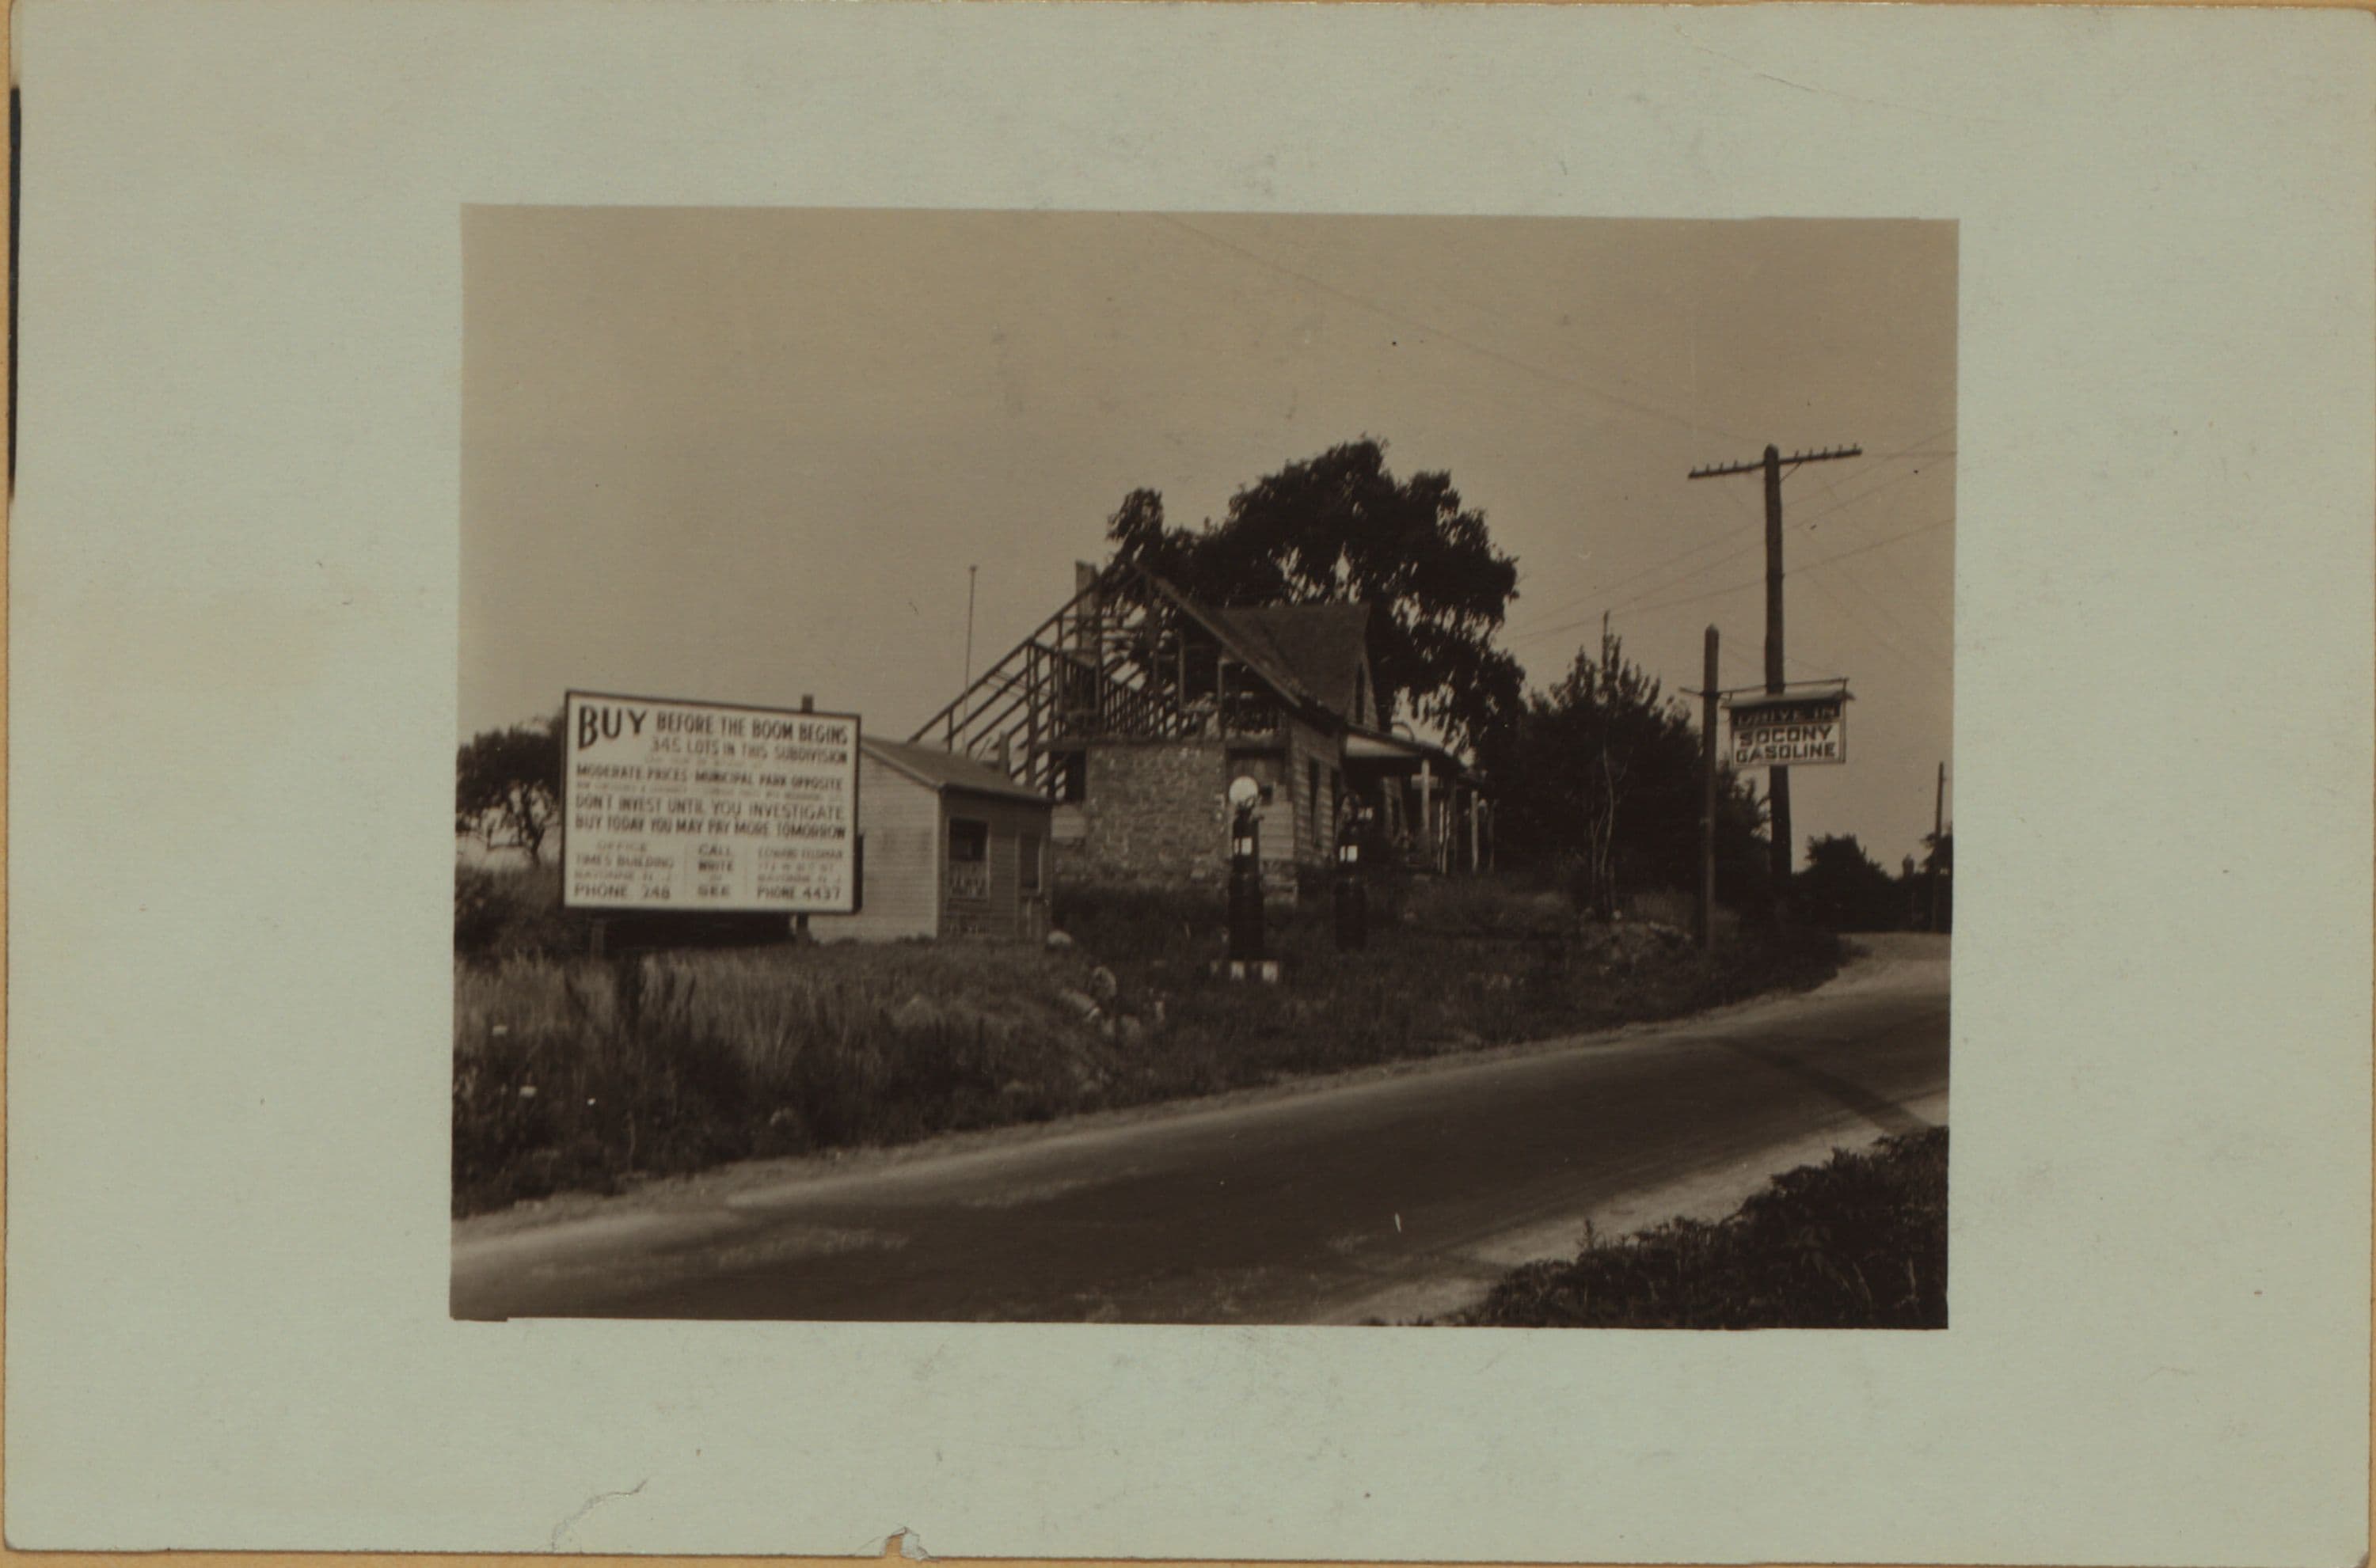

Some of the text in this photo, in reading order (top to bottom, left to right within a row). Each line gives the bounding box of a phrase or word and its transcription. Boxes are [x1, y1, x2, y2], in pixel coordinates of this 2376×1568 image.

[578, 705, 647, 750] BUY
[656, 713, 849, 744] BEFORE THE BOOM BEGINS
[1739, 724, 1833, 746] SOCONY
[686, 738, 718, 755] LOTS
[724, 741, 736, 755] IN
[741, 742, 768, 760] THIS
[774, 745, 848, 765] SUBDIVISION
[1736, 742, 1836, 763] GASOLINE
[576, 763, 843, 792] MODERATE PRICES MUNICIPAL PARK OPPOSITE
[618, 796, 661, 813] INVEST
[667, 797, 705, 814] UNTIL
[712, 798, 741, 817] YOU
[749, 800, 843, 821] INVESTIGATE
[576, 814, 846, 840] BUY TODAY YOU MAY PAY MORE TOMORROW
[698, 842, 731, 856] CALL
[574, 883, 628, 899] PHONE
[756, 885, 795, 900] PHONE
